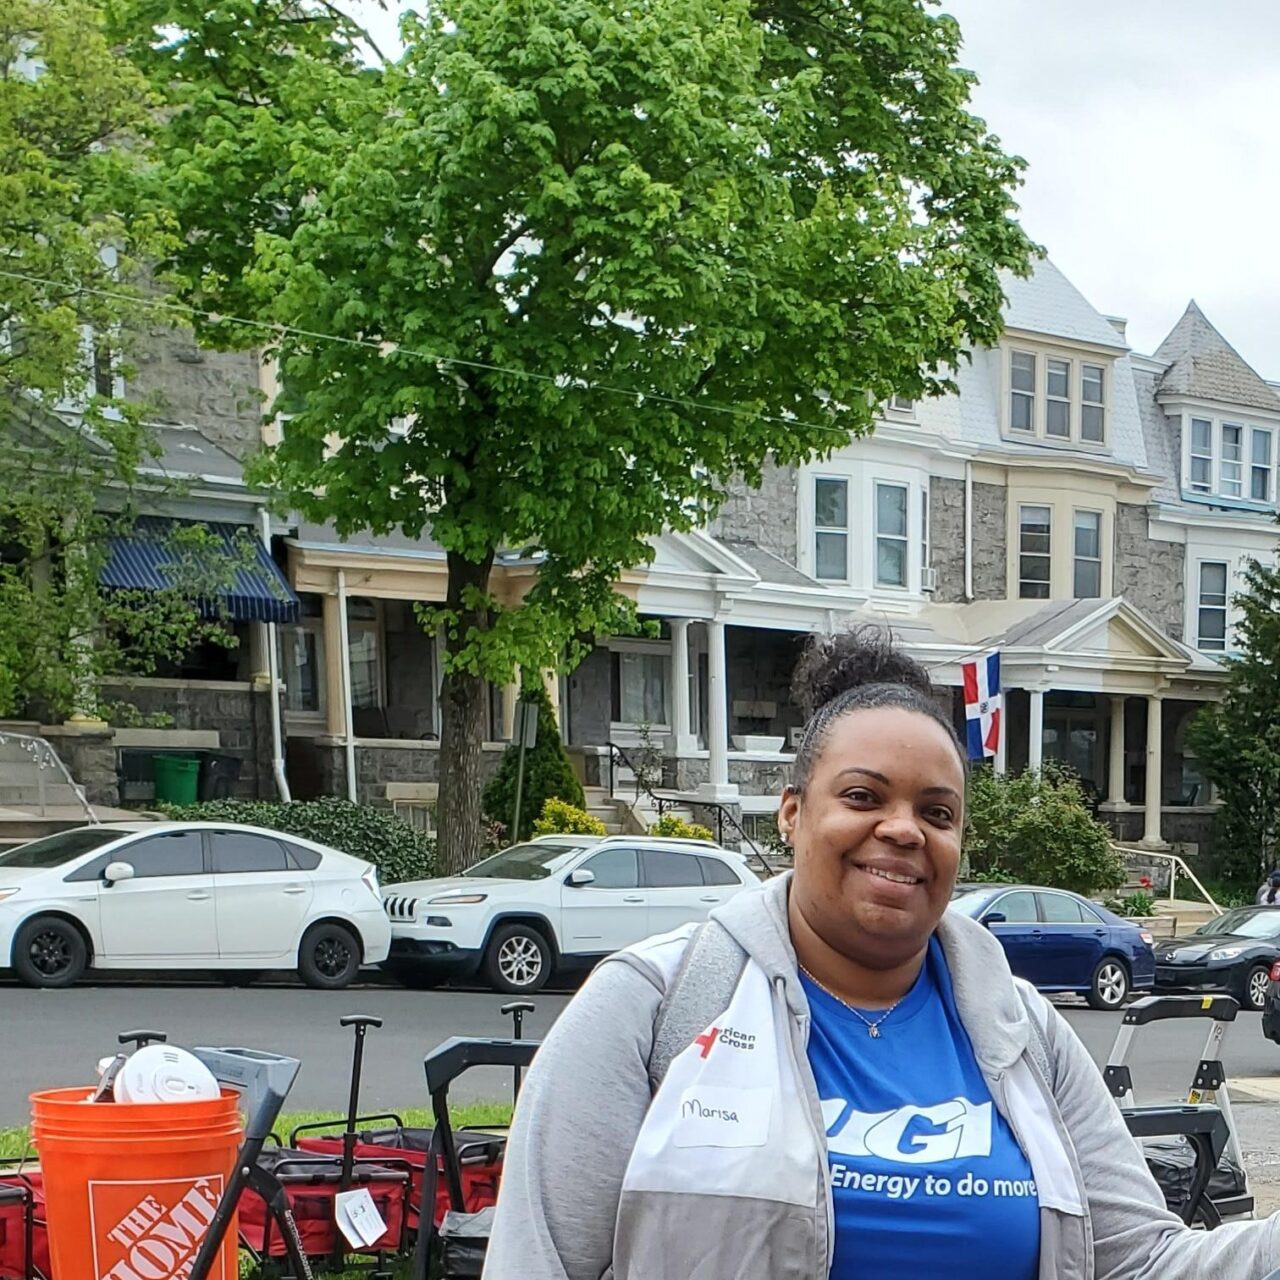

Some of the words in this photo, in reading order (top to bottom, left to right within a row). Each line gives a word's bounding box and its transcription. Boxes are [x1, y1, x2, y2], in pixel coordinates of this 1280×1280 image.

[719, 1027, 756, 1043] rican
[719, 1035, 755, 1050] Cross
[682, 1098, 739, 1123] Marisa
[820, 1097, 992, 1164] UGI
[831, 1163, 920, 1200] Energy
[924, 1173, 951, 1196] to
[956, 1172, 989, 1197] do
[107, 1195, 168, 1249] THE
